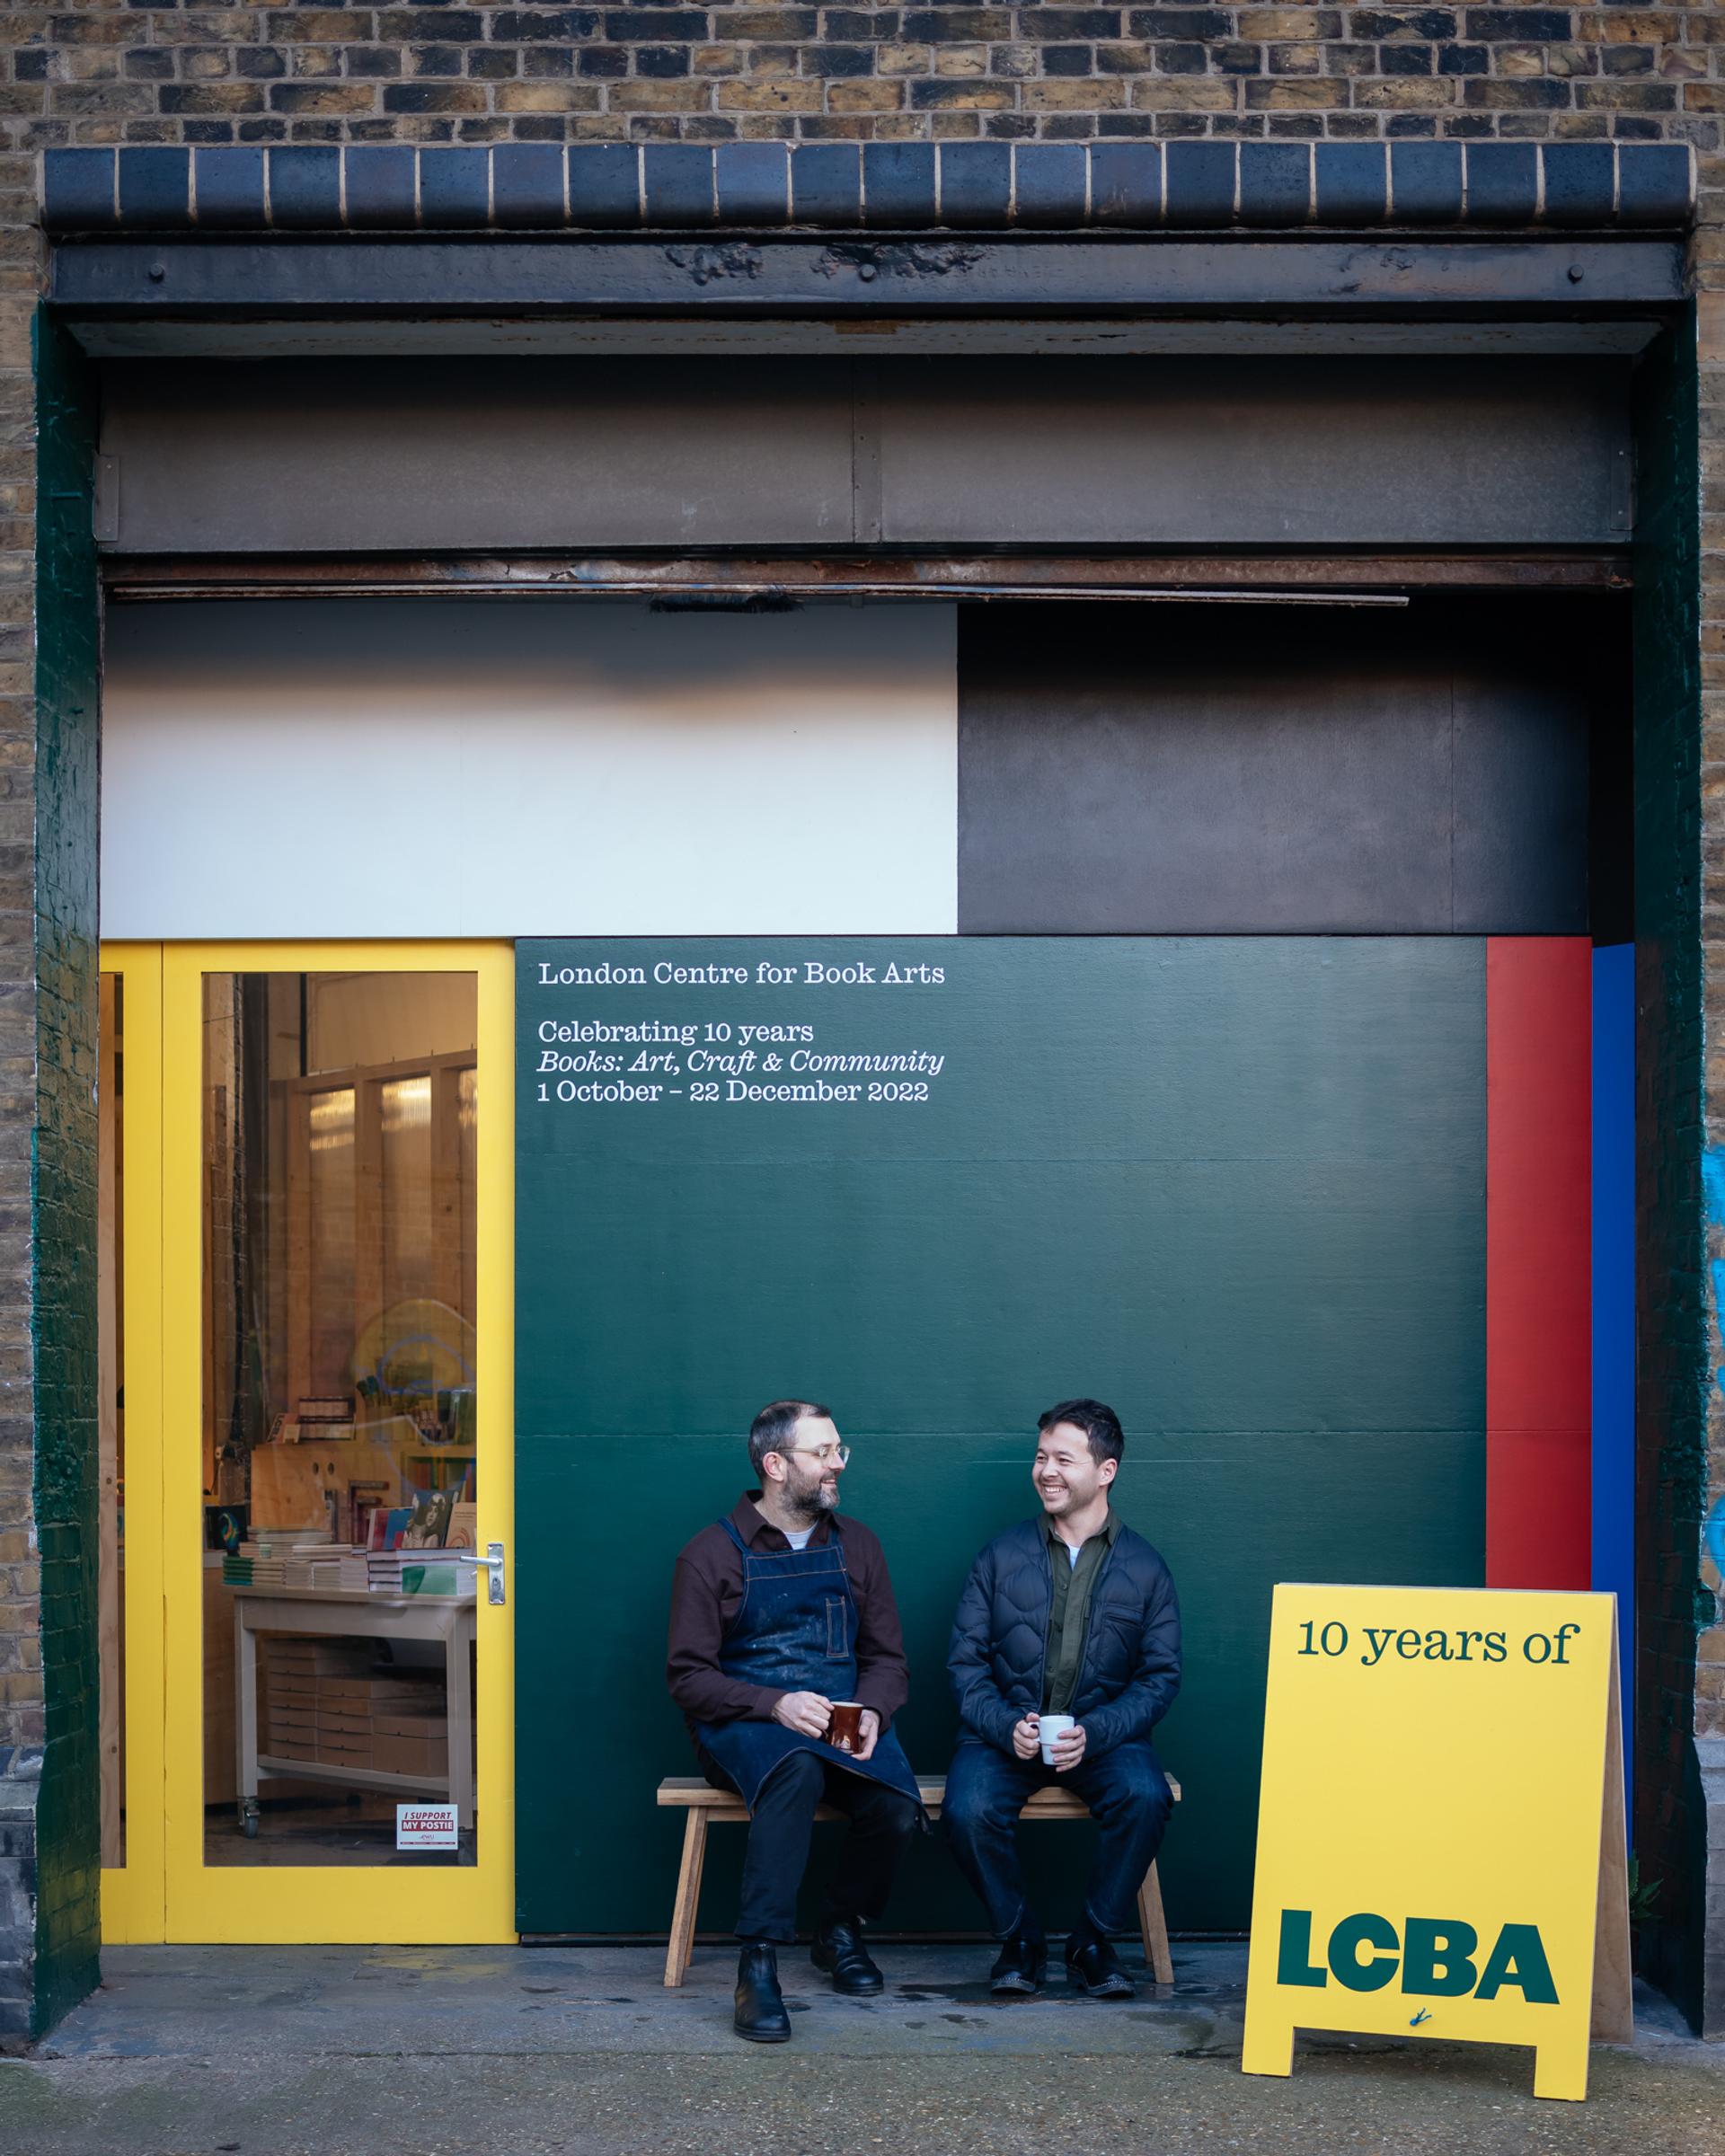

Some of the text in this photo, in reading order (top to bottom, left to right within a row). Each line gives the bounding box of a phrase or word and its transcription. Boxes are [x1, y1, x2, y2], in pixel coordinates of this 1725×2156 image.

[539, 961, 946, 985] London Centre for Book Arts
[538, 1020, 814, 1047] Celebrating 10 years
[536, 1049, 945, 1076] Books: Art, Craft & Community
[537, 1082, 550, 1102] 1
[556, 1080, 664, 1102] October
[689, 1082, 720, 1102] 22
[726, 1080, 862, 1102] December
[868, 1082, 929, 1102] 2022
[1297, 1620, 1581, 1666] 10 years of
[402, 1821, 453, 1830] MY POSTIE
[1277, 1909, 1561, 2005] LCBA
